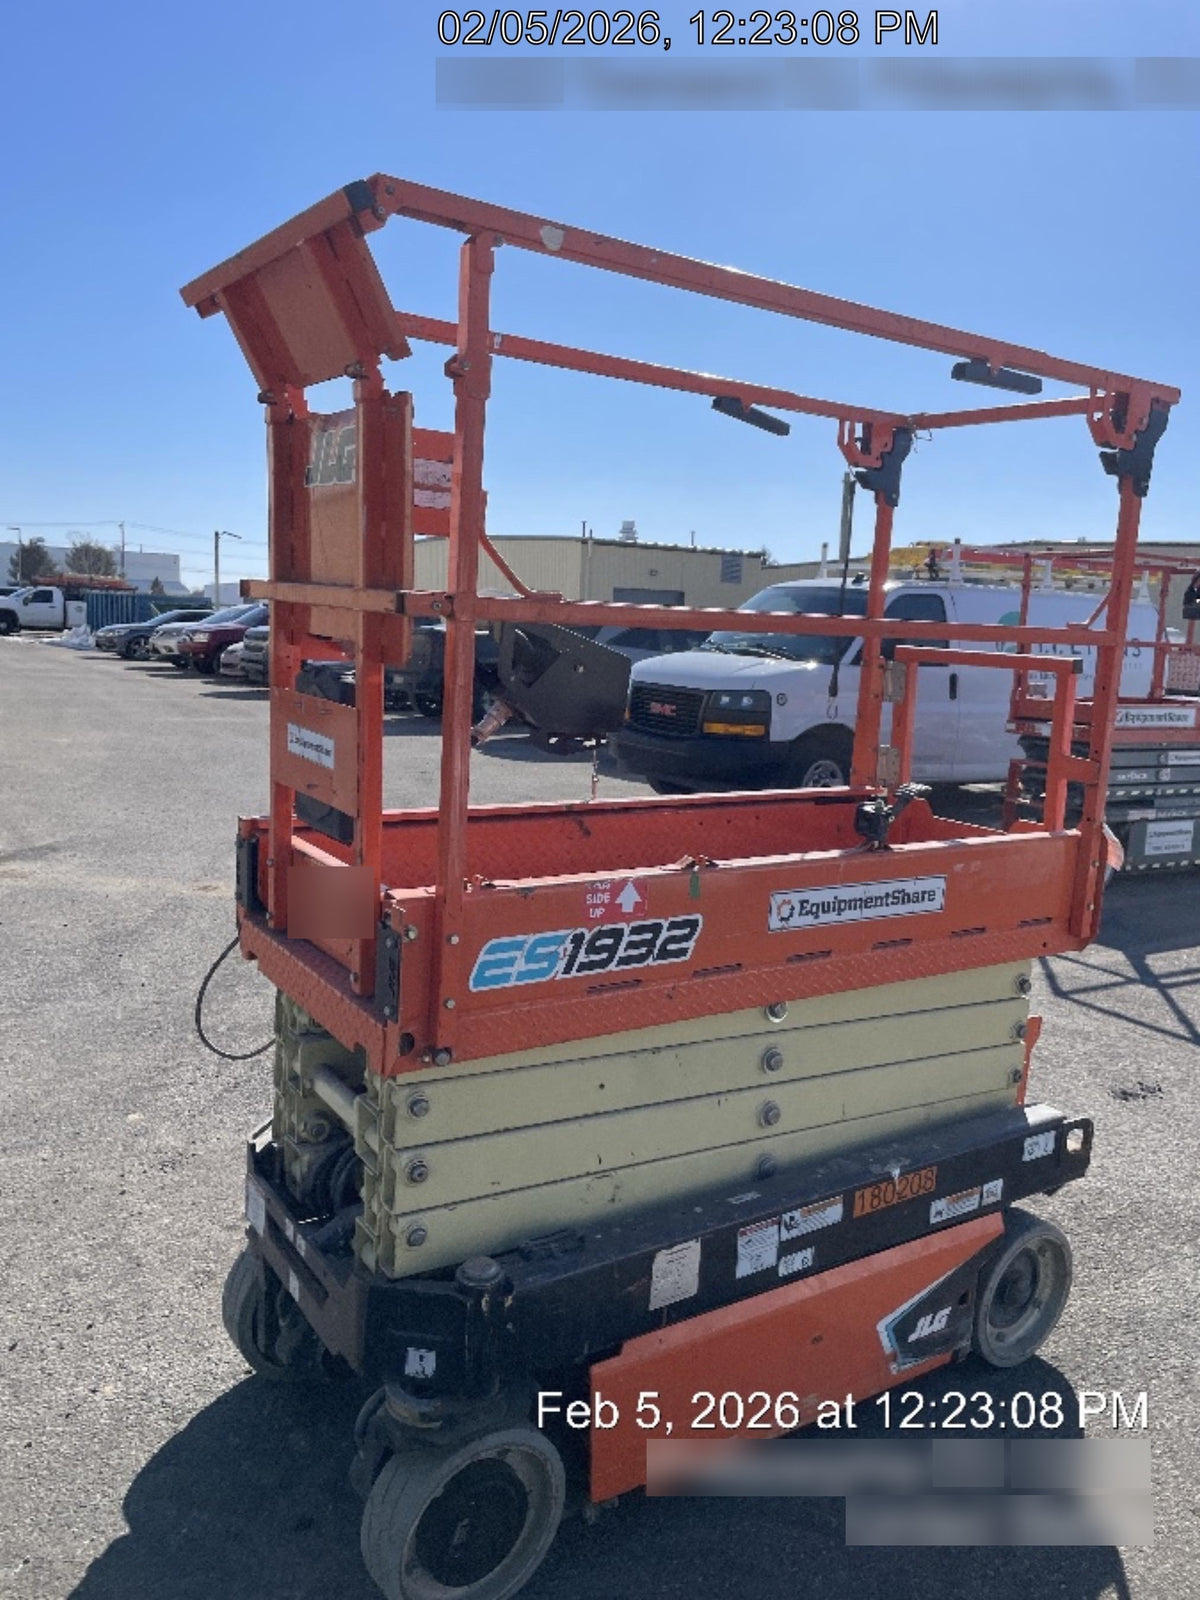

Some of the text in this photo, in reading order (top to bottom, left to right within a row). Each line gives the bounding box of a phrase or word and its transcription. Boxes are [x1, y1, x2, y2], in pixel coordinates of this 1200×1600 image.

[586, 892, 611, 904] SIDE
[589, 907, 605, 918] UP
[798, 888, 937, 920] EquipmentShare
[469, 913, 703, 991] ES1932
[858, 1168, 936, 1213] 180208
[907, 1306, 952, 1343] JLG
